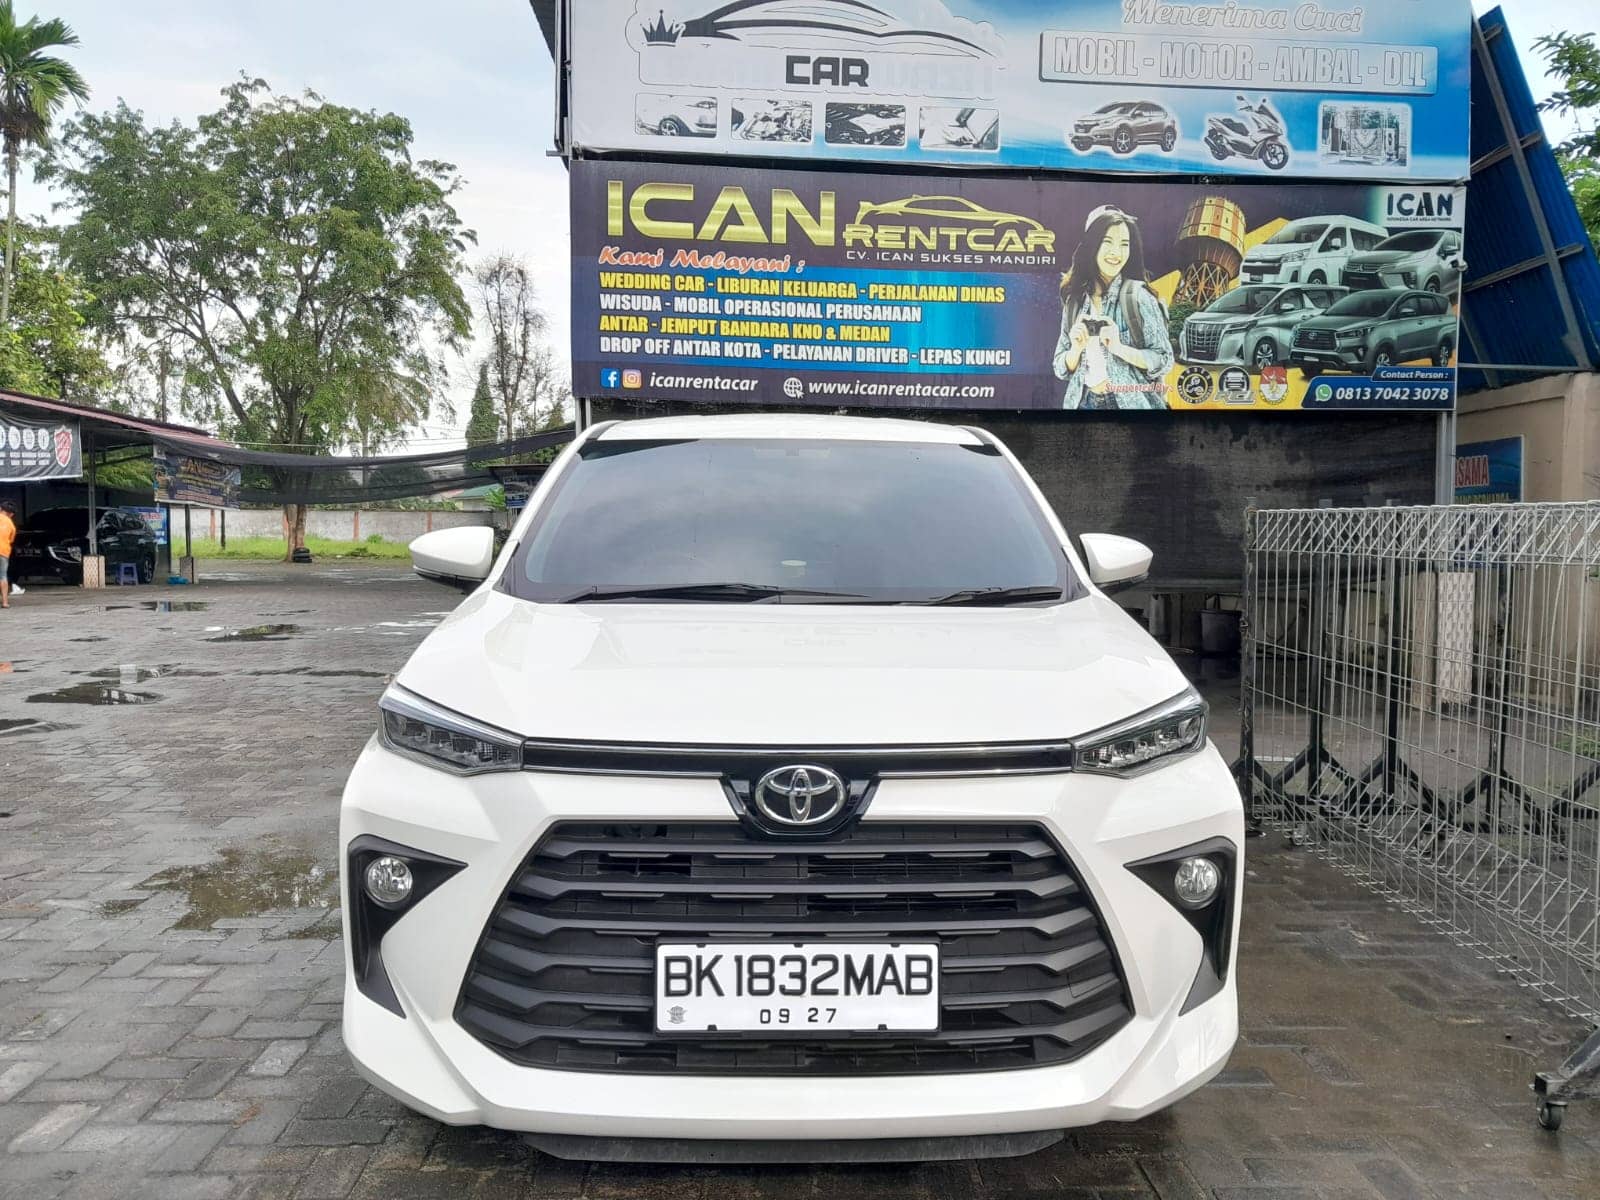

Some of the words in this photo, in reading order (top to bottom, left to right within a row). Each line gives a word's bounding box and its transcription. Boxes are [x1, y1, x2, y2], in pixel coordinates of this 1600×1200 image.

[1124, 0, 1287, 29] Menerima
[1294, 3, 1363, 32] Cuci
[786, 55, 869, 87] CAR
[1054, 37, 1138, 76] MOBIL
[1160, 41, 1253, 80] MOTOR
[1273, 46, 1362, 84] AMBAL
[1384, 51, 1427, 87] DLL
[607, 180, 835, 246] ICAN
[1388, 192, 1453, 216] ICAN
[843, 223, 1055, 253] RENTCAR
[599, 246, 664, 268] Kami
[670, 249, 791, 274] Melayani
[846, 250, 870, 261] CV.
[876, 252, 913, 262] ICAN
[920, 253, 983, 264] SUKSES
[990, 255, 1056, 265] MANDIRI
[599, 272, 672, 291] WEDDING
[674, 275, 705, 292] CAR
[717, 277, 780, 296] LIBURAN
[783, 280, 857, 299] KELUARGA
[869, 284, 957, 302] PERJALANAN
[960, 286, 1005, 303] DINAS
[599, 294, 662, 311] WISUDA
[674, 297, 721, 314] MOBIL
[724, 299, 823, 318] OPERASIONAL
[826, 304, 922, 322] PERUSAHAAN
[599, 315, 648, 332] ANTAR
[660, 317, 717, 335] JEMPUT
[720, 320, 789, 338] BANDARA
[792, 324, 822, 340] KNO
[825, 326, 836, 340] &
[839, 325, 890, 342] MEDAN
[600, 336, 641, 353] DROP
[644, 338, 671, 355] OFF
[673, 339, 721, 357] ANTAR
[724, 342, 762, 359] KOTA
[773, 343, 851, 362] PELAYANAN
[856, 346, 908, 363] DRIVER
[920, 349, 962, 365] LEPAS
[965, 350, 1011, 365] KUNCI
[650, 372, 758, 391] icanrentacar
[1380, 370, 1413, 379] Contact
[1415, 371, 1444, 379] Person
[808, 380, 995, 398] www.icanrentacar.com
[1336, 387, 1371, 400] 0813
[1374, 387, 1409, 400] 7042
[1412, 387, 1449, 400] 3078
[1455, 455, 1489, 487] SAMA
